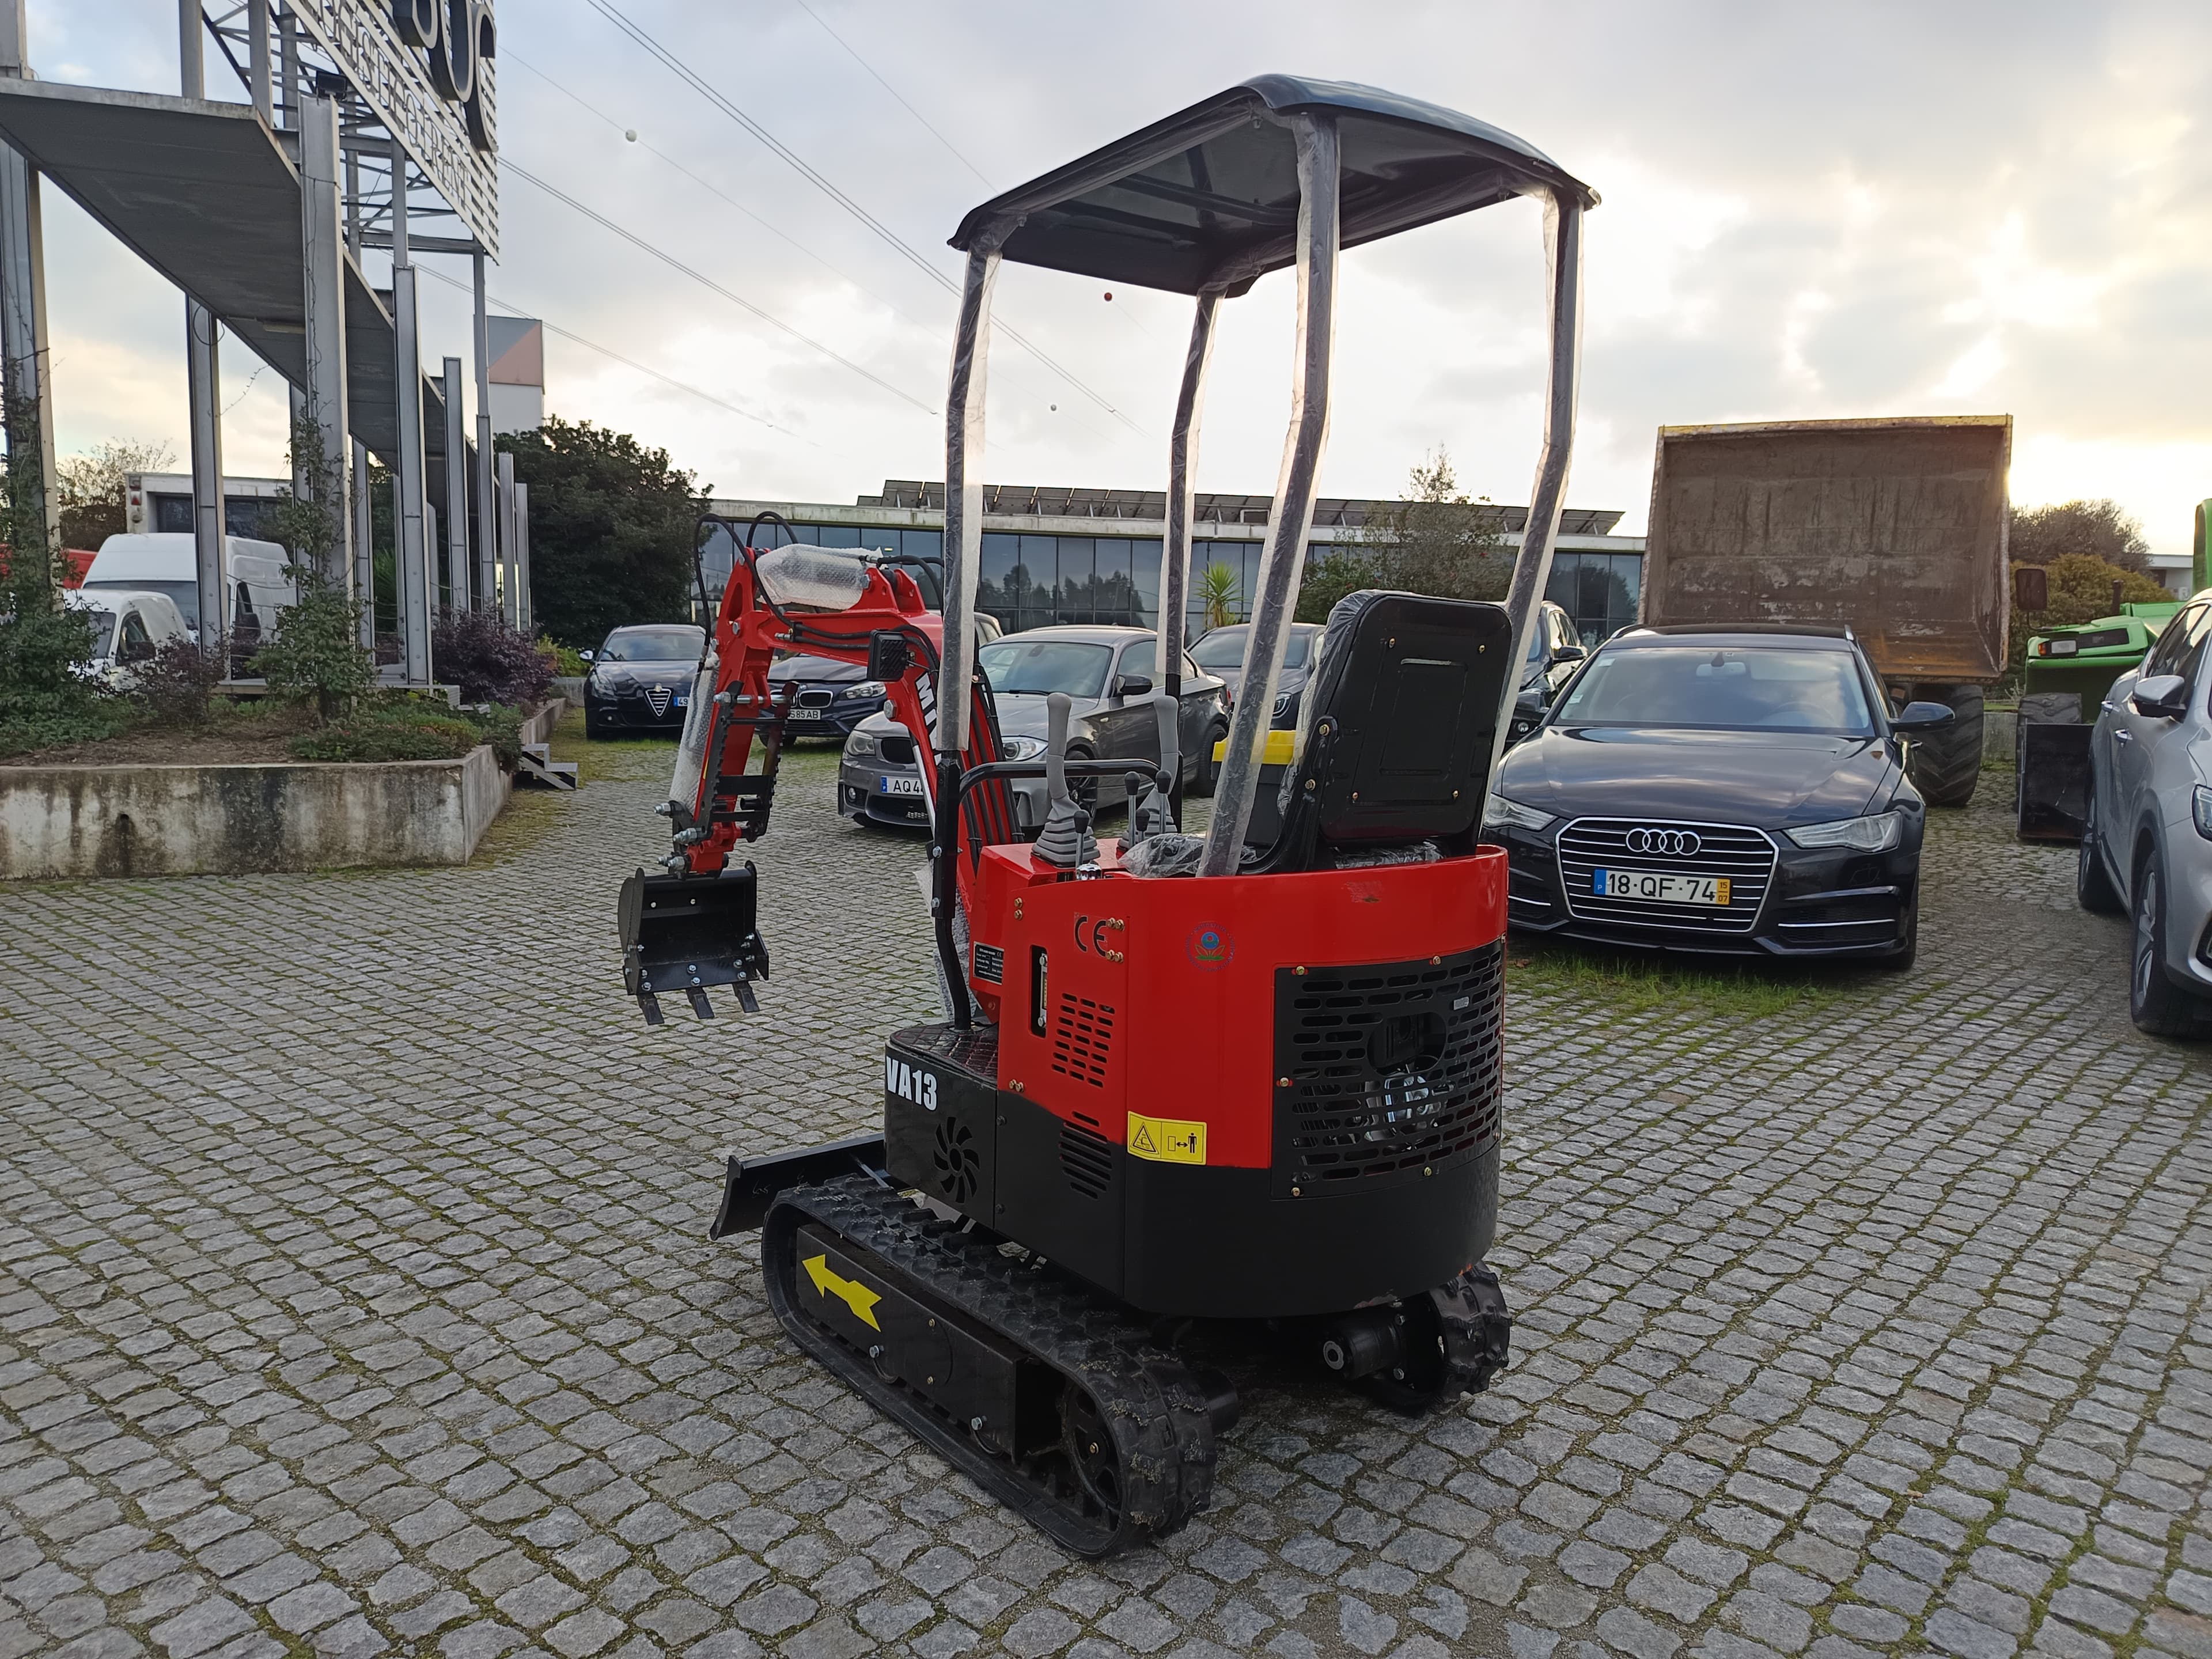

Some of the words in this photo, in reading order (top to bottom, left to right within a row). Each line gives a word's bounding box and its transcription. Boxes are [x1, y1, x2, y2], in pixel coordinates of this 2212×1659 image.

[1719, 881, 1728, 889] 15
[1074, 915, 1107, 957] CE
[886, 1055, 937, 1111] VA13
